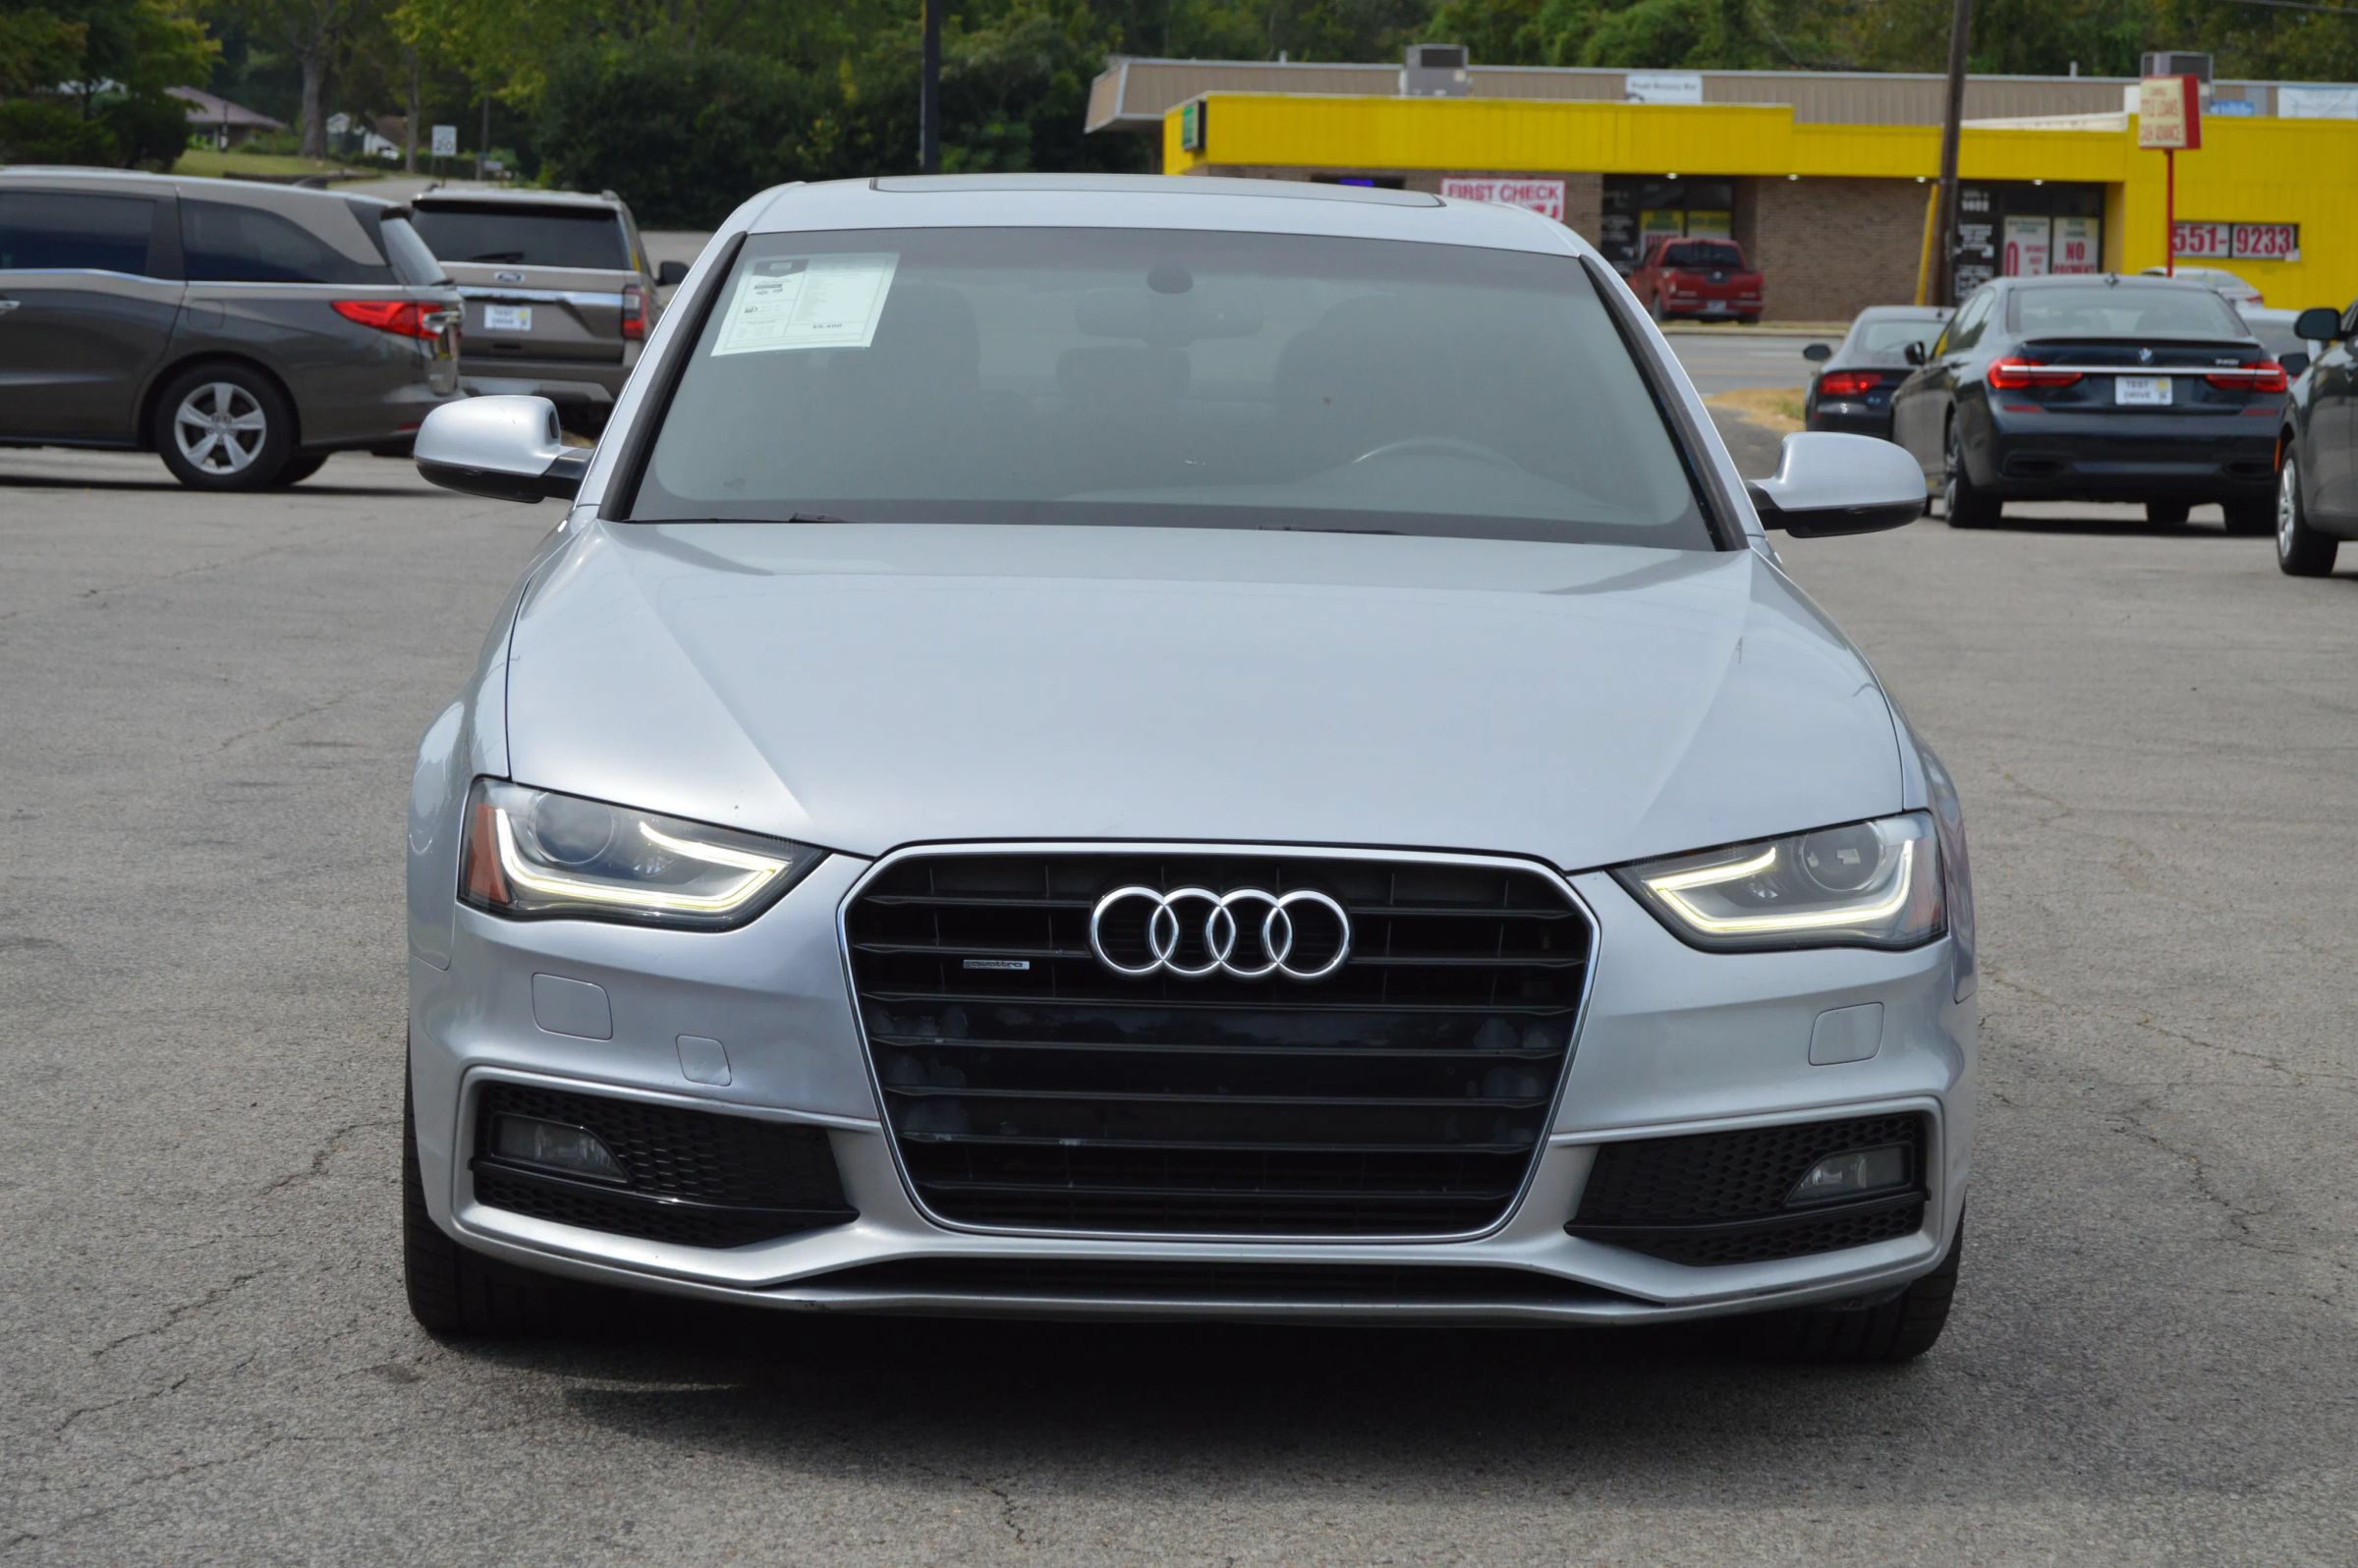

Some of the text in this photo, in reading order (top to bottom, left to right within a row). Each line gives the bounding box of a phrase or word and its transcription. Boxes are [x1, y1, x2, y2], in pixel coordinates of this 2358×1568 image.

[1448, 183, 1558, 202] FIRST CHECK
[2236, 226, 2291, 253] 9233
[2066, 242, 2085, 260] NO
[2126, 379, 2149, 388] TEST
[969, 961, 1024, 970] quattro
